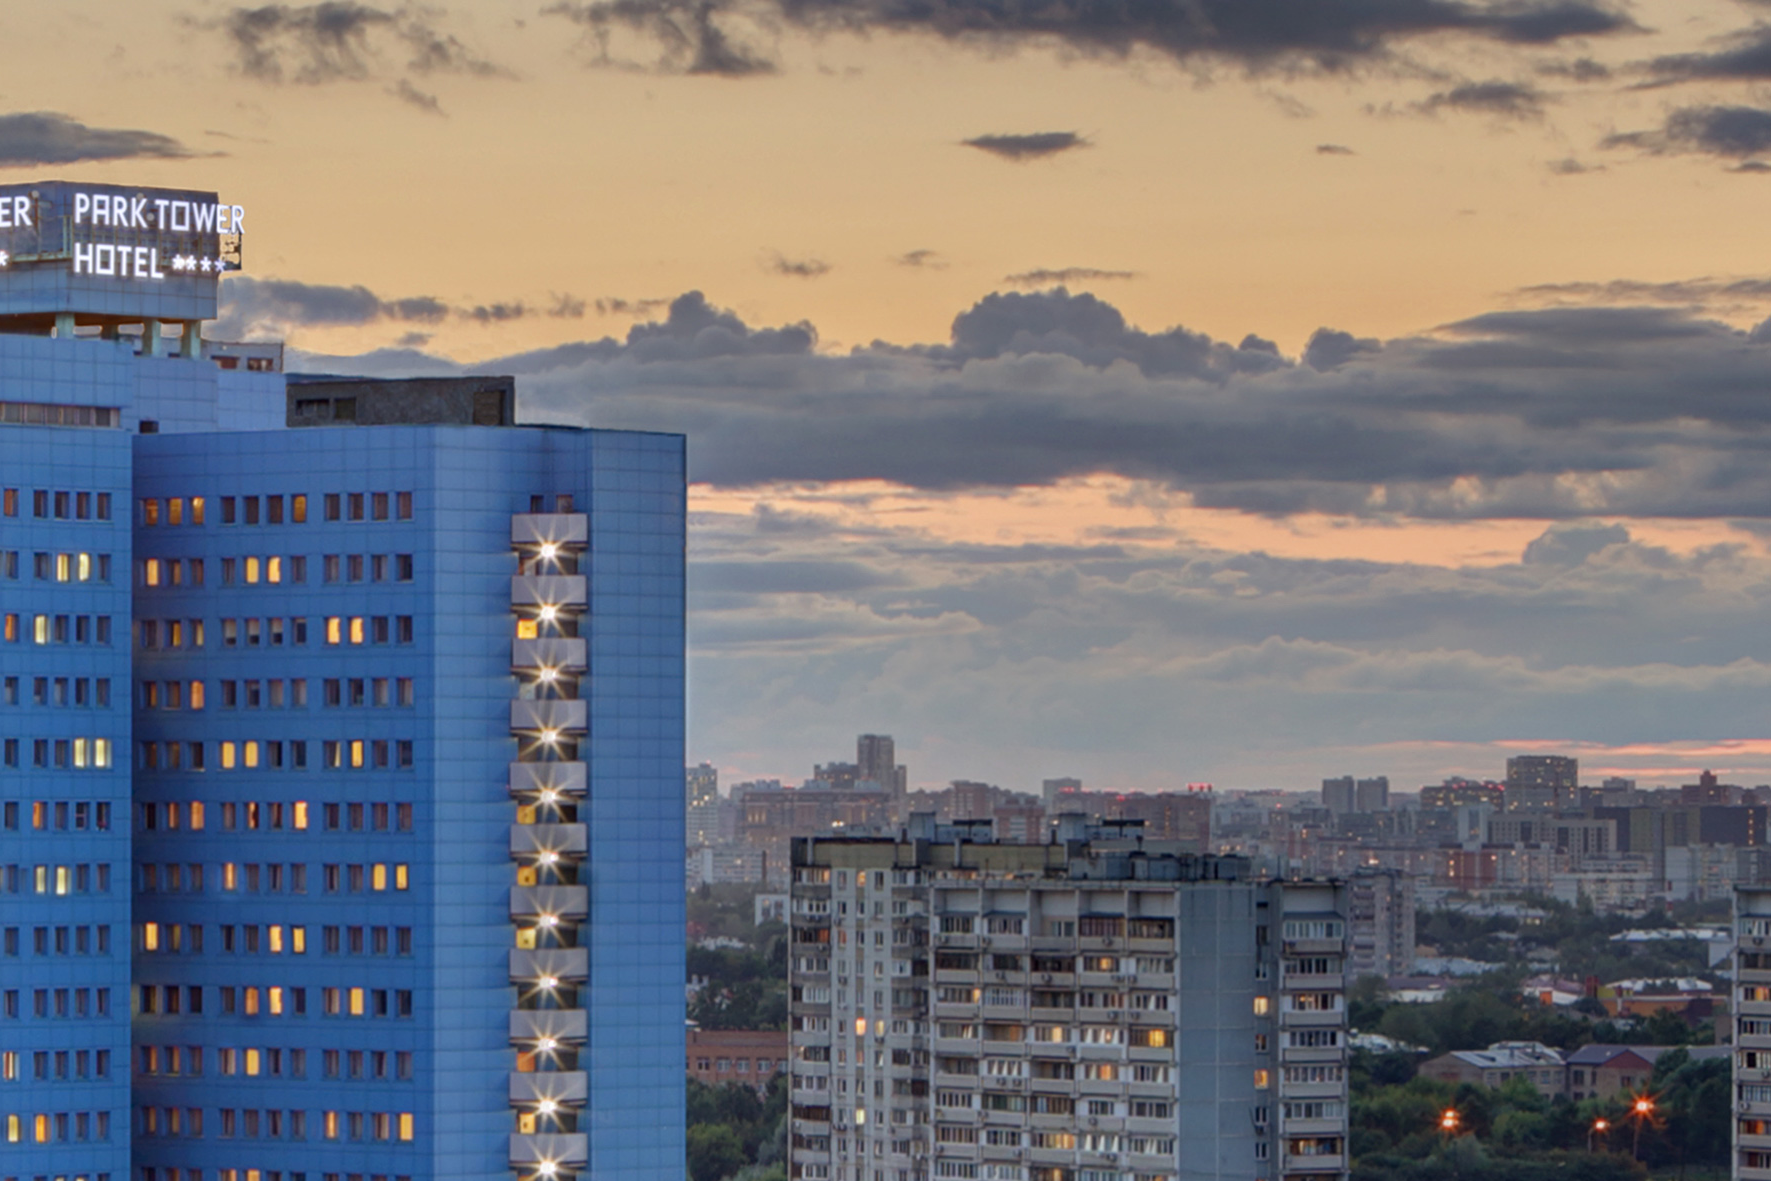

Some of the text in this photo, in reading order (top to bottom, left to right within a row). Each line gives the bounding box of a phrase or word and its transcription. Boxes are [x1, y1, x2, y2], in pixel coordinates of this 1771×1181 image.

[75, 193, 245, 235] PARK TOWER
[74, 243, 165, 279] HOTEL
